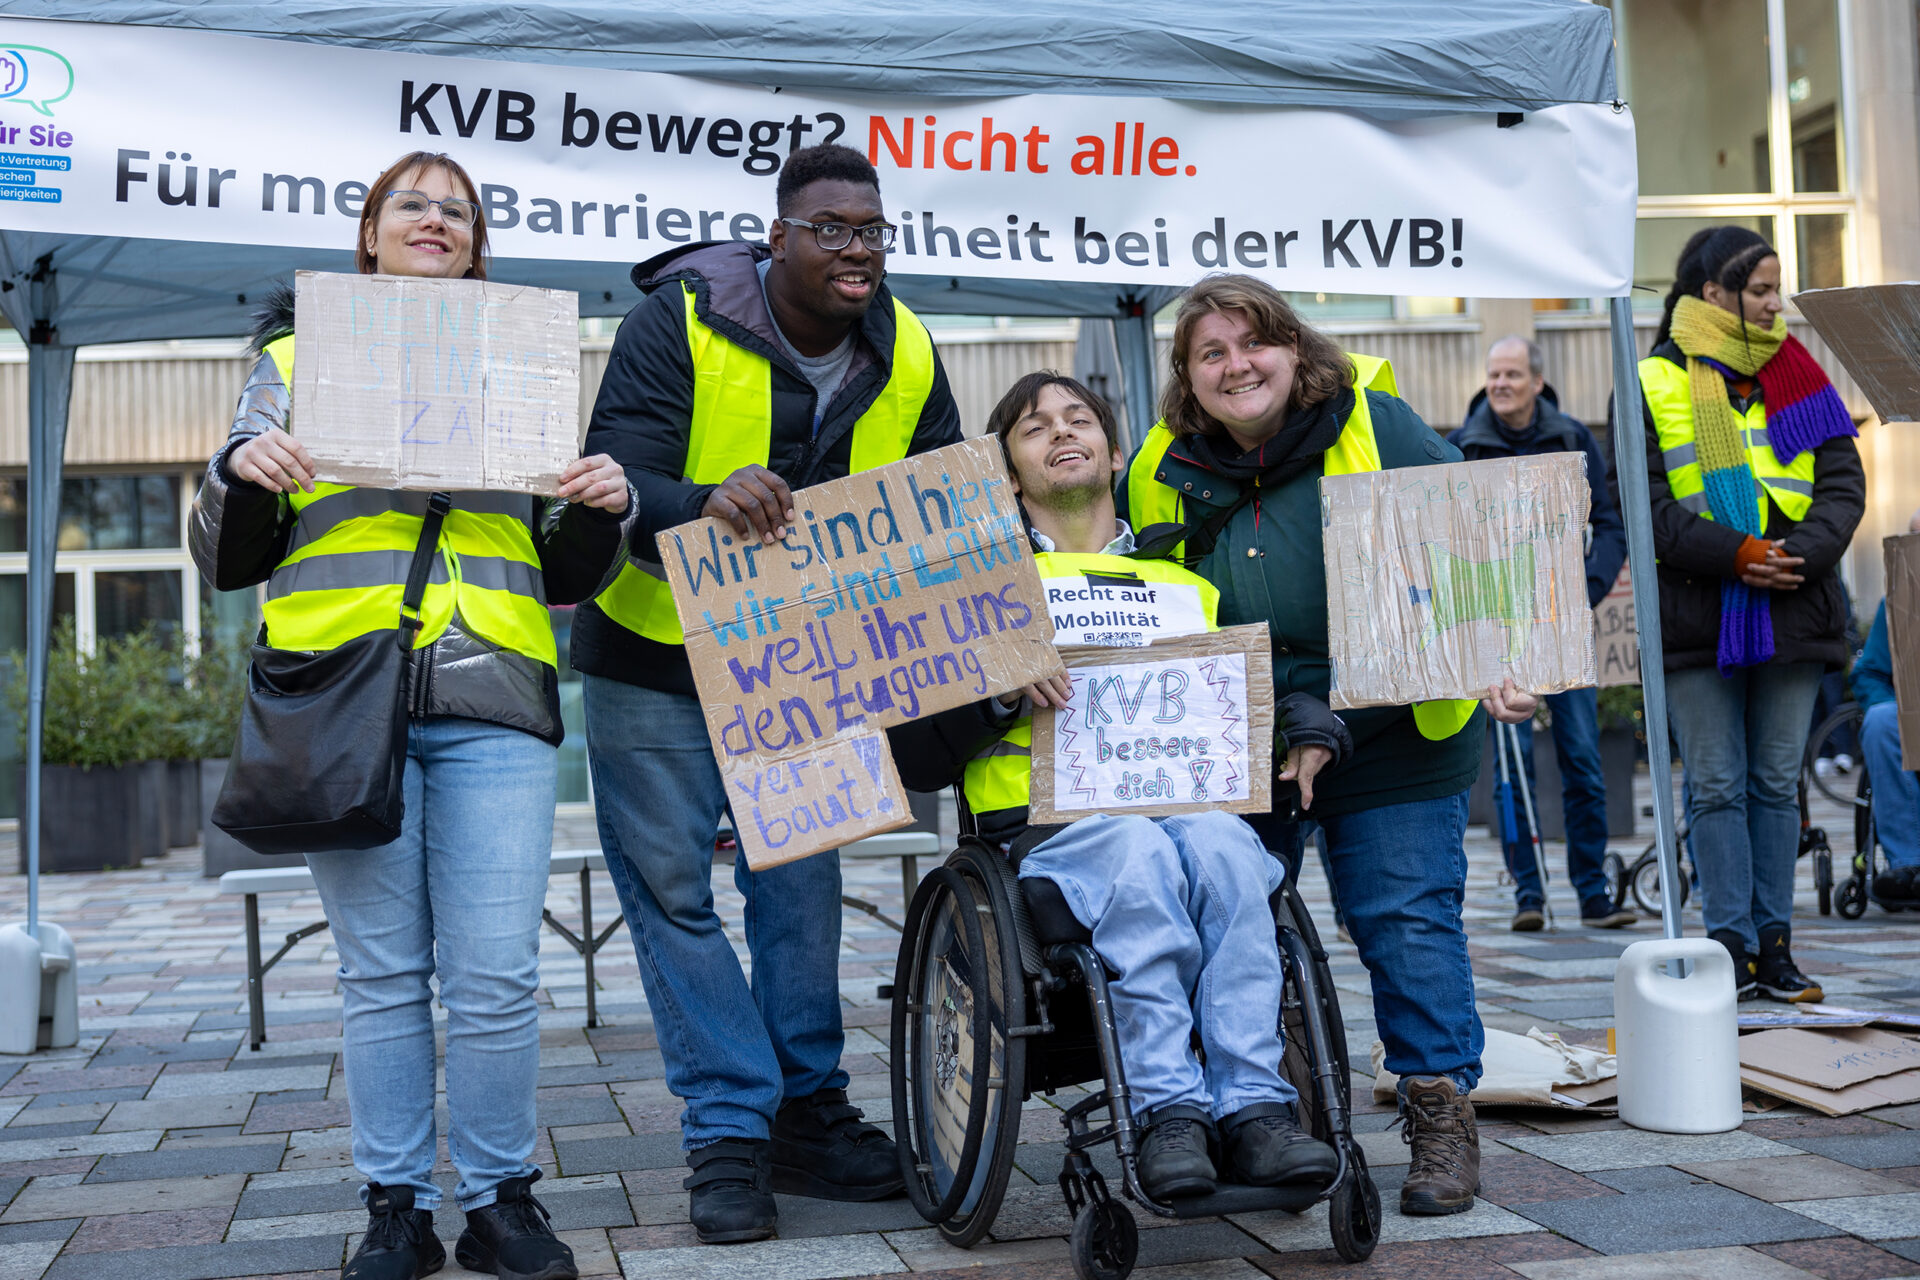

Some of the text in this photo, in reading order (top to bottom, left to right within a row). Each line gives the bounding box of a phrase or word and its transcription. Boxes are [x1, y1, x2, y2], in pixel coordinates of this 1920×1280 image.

[30, 124, 73, 148] Sie
[400, 80, 1197, 177] KVB bewegt? Nicht alle.
[117, 148, 236, 208] Für
[1074, 217, 1169, 267] bei
[1192, 217, 1298, 268] der
[1322, 218, 1463, 268] KVB!
[351, 296, 507, 339] DEINE
[362, 342, 558, 402] STIMME
[391, 400, 567, 450] ZÄHLT
[677, 473, 1001, 597] Wir sind hier
[801, 552, 901, 619] sind
[1049, 586, 1157, 603] Recht auf
[728, 583, 1032, 694] weil ihr uns
[1055, 611, 1160, 630] Mobilität
[721, 647, 987, 756] den Zugang
[1086, 669, 1189, 728] KVB
[1097, 727, 1210, 763] bessere
